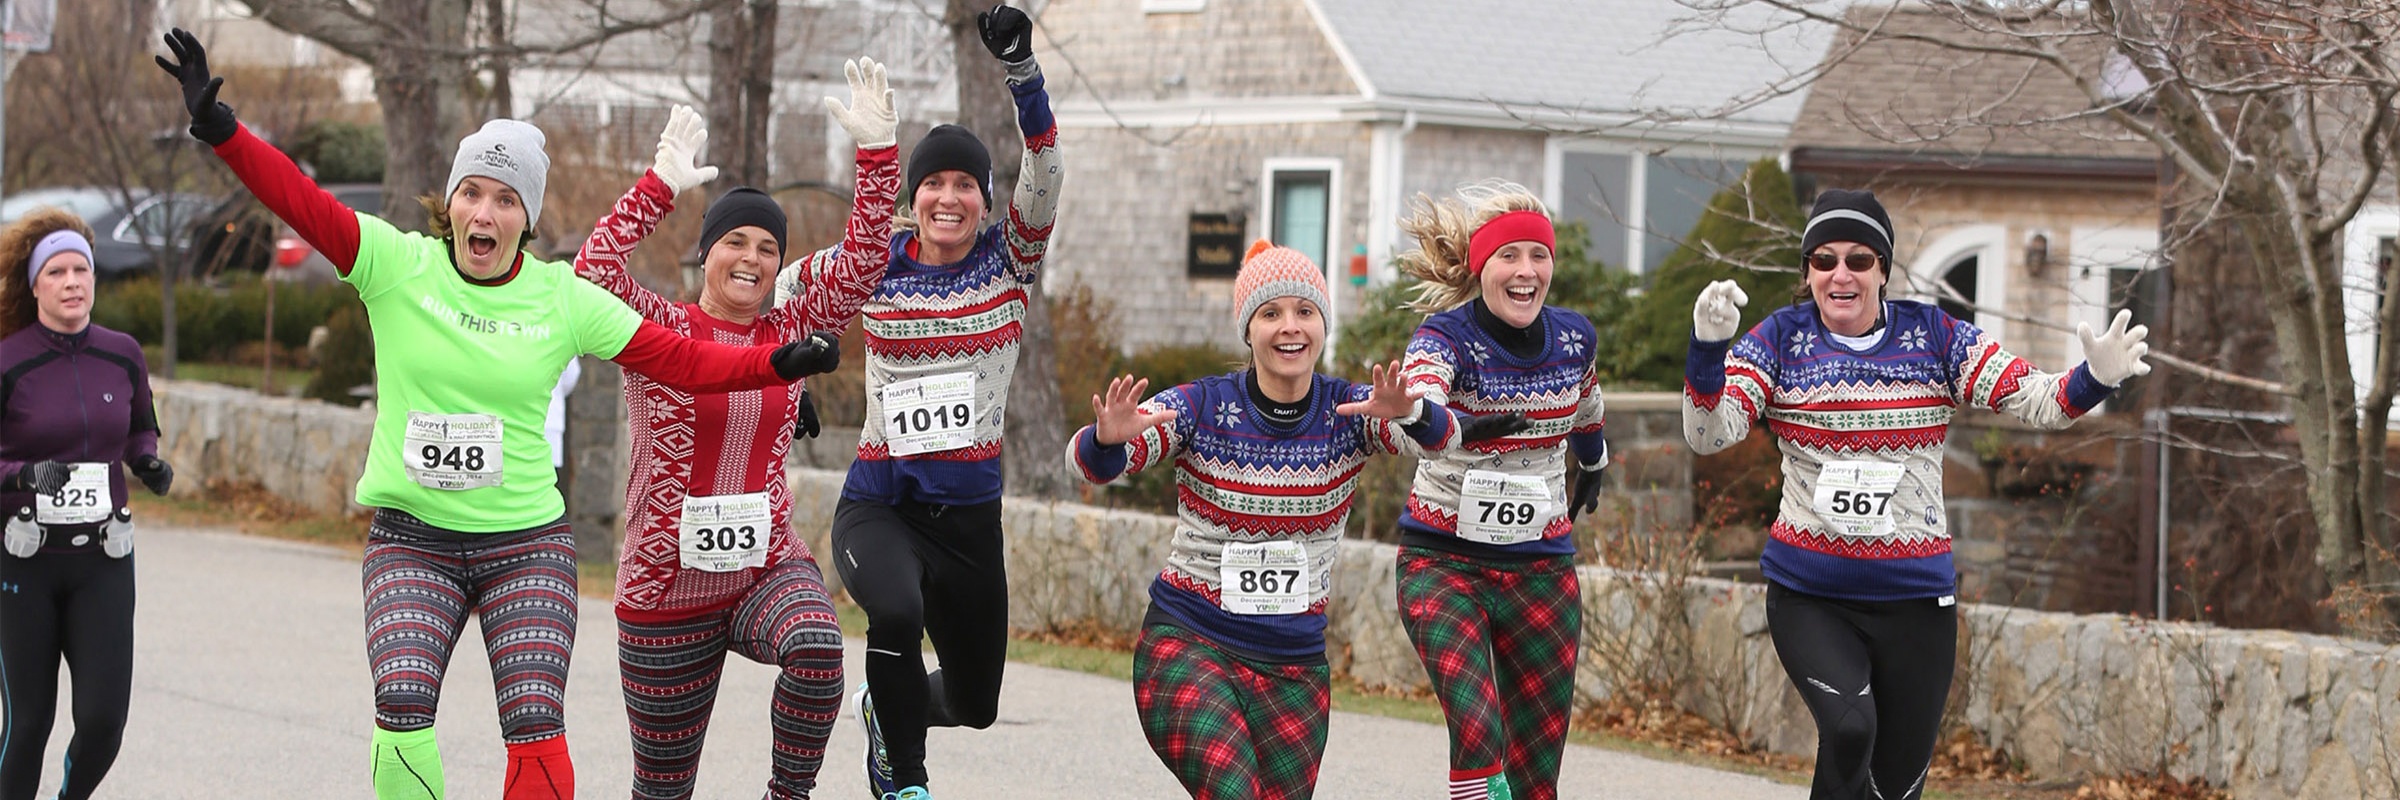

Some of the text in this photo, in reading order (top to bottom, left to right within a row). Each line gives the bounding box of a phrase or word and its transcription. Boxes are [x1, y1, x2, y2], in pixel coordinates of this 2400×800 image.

[474, 154, 519, 171] RUNNING
[888, 380, 969, 399] HAPPY HOLIDAYS
[412, 418, 496, 430] HAPPY HOLIDAYS
[893, 403, 970, 435] 1019
[906, 435, 938, 444] December
[422, 445, 485, 471] 948
[422, 472, 456, 480] December
[1825, 467, 1900, 478] HAPPY HOLIDAYS
[1469, 478, 1499, 487] HAPPY
[52, 488, 97, 508] 825
[1832, 490, 1892, 516] 567
[686, 501, 764, 513] HAPPY HOLIDAYS
[1478, 501, 1535, 526] 769
[1832, 517, 1864, 525] December
[696, 525, 756, 551] 303
[697, 554, 730, 562] December
[1240, 569, 1300, 594] 867
